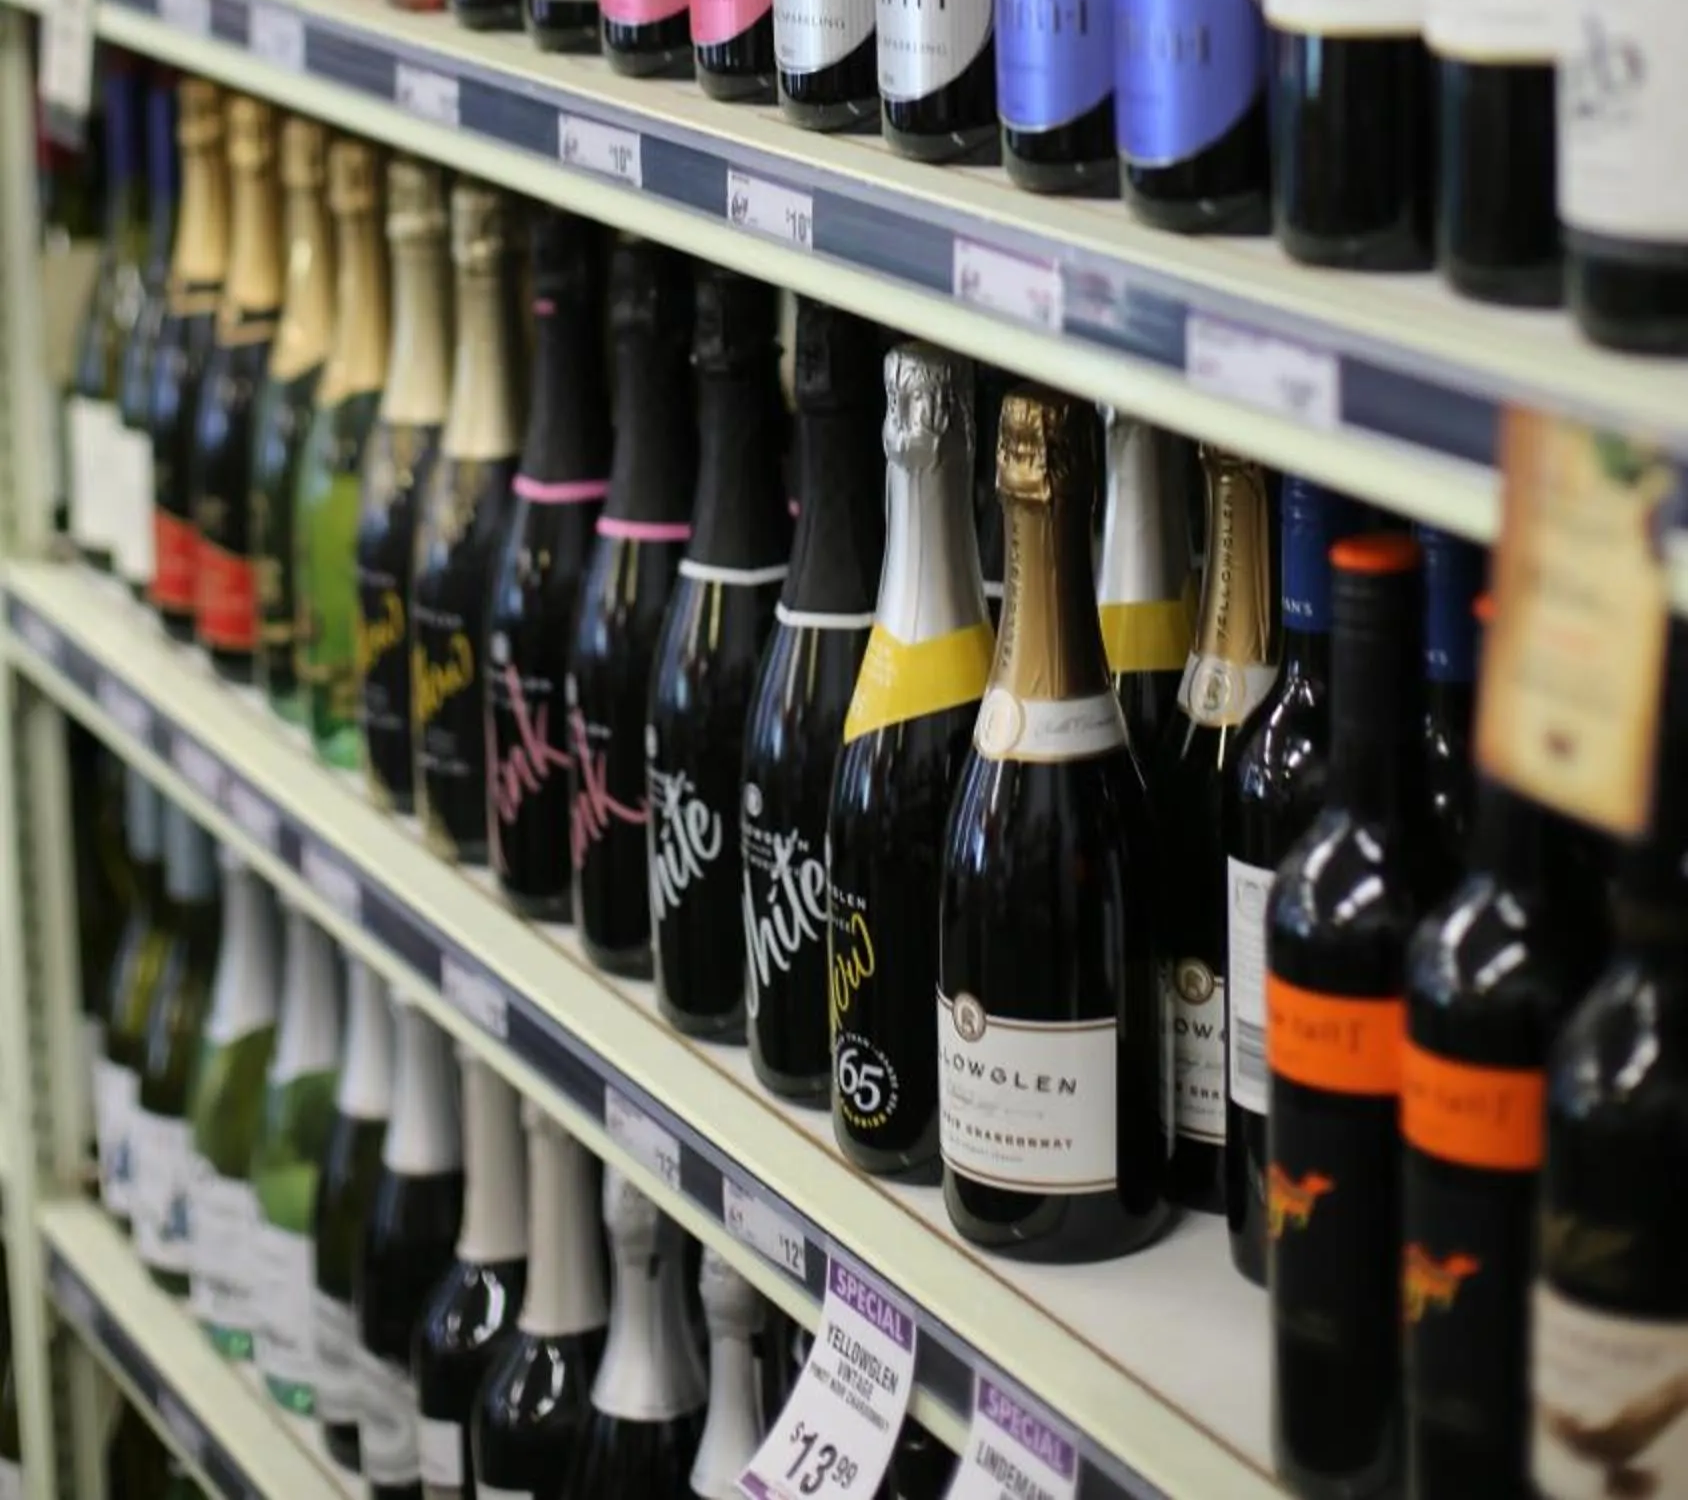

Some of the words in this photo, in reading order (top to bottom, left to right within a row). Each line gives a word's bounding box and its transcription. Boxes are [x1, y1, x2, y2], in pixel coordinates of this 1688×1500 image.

[839, 1048, 881, 1113] 65
[836, 1267, 906, 1343] SPECIAL
[827, 1320, 899, 1396] YELLOWGLEN
[984, 1386, 1066, 1470] SPECIAL
